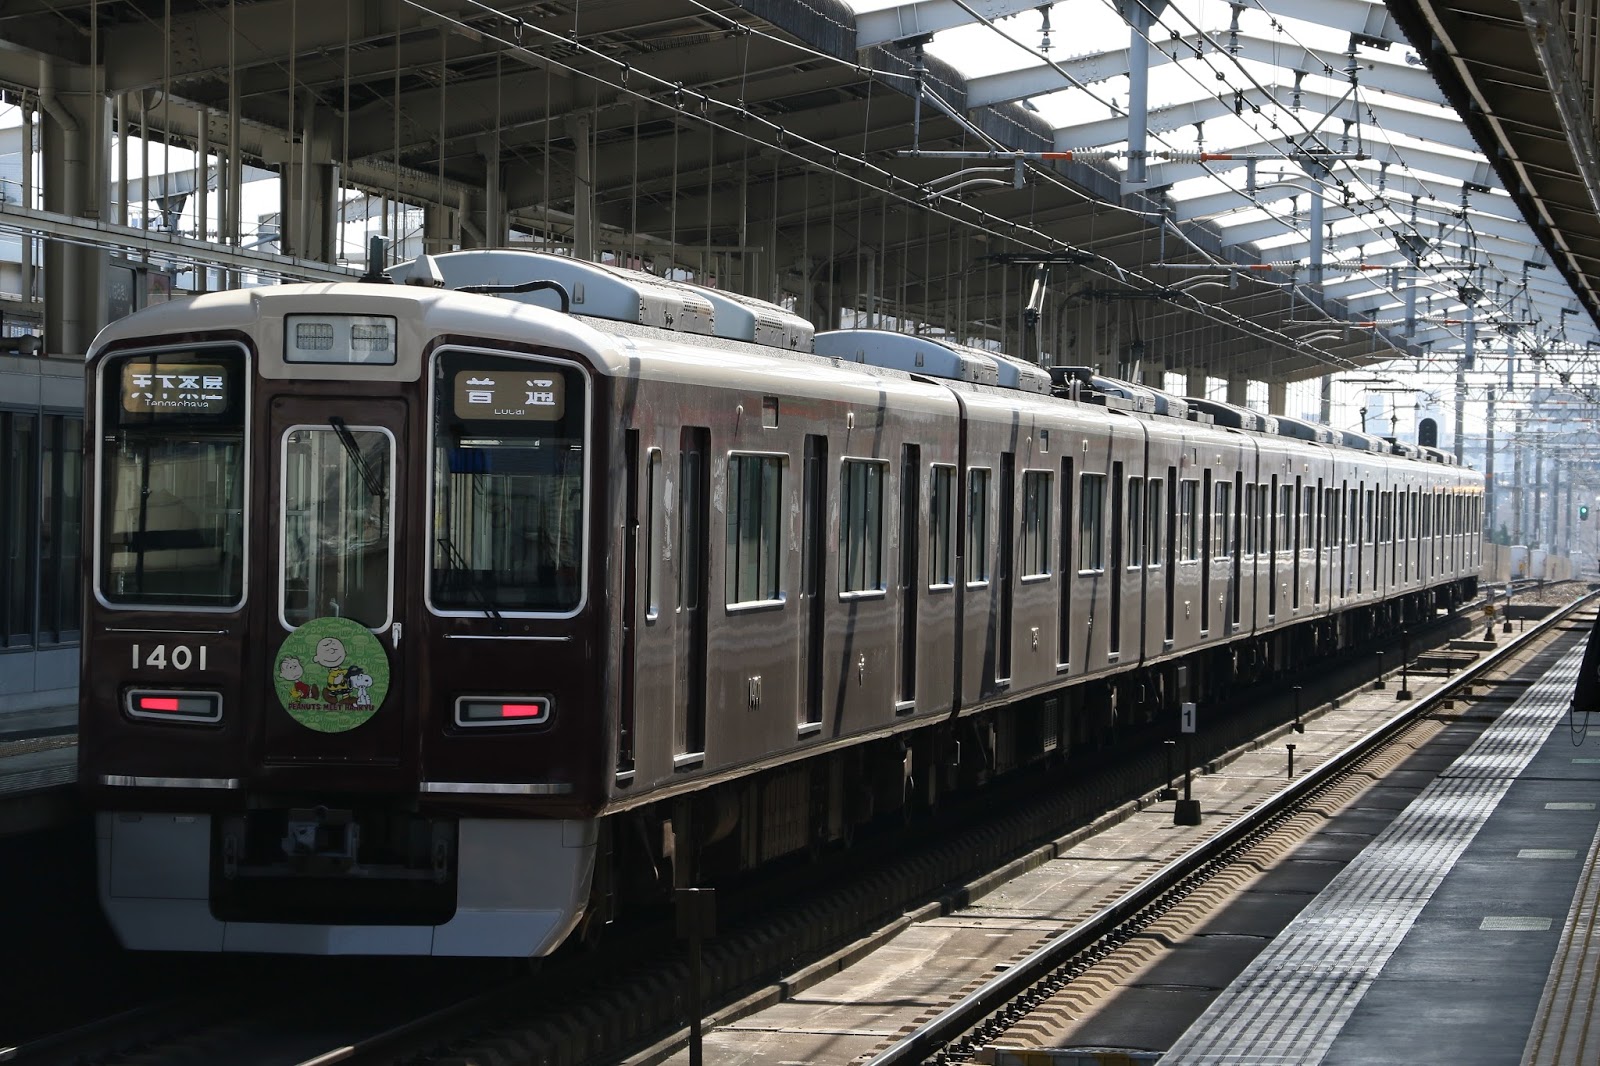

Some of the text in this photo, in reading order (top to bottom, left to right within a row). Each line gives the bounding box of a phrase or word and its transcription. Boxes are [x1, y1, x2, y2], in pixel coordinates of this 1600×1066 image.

[131, 374, 224, 400] 天下茶屋
[465, 377, 556, 405] 普通
[132, 644, 207, 671] 1401
[288, 702, 321, 711] PEANUTS
[323, 703, 343, 711] MEET
[1183, 710, 1192, 727] 1
